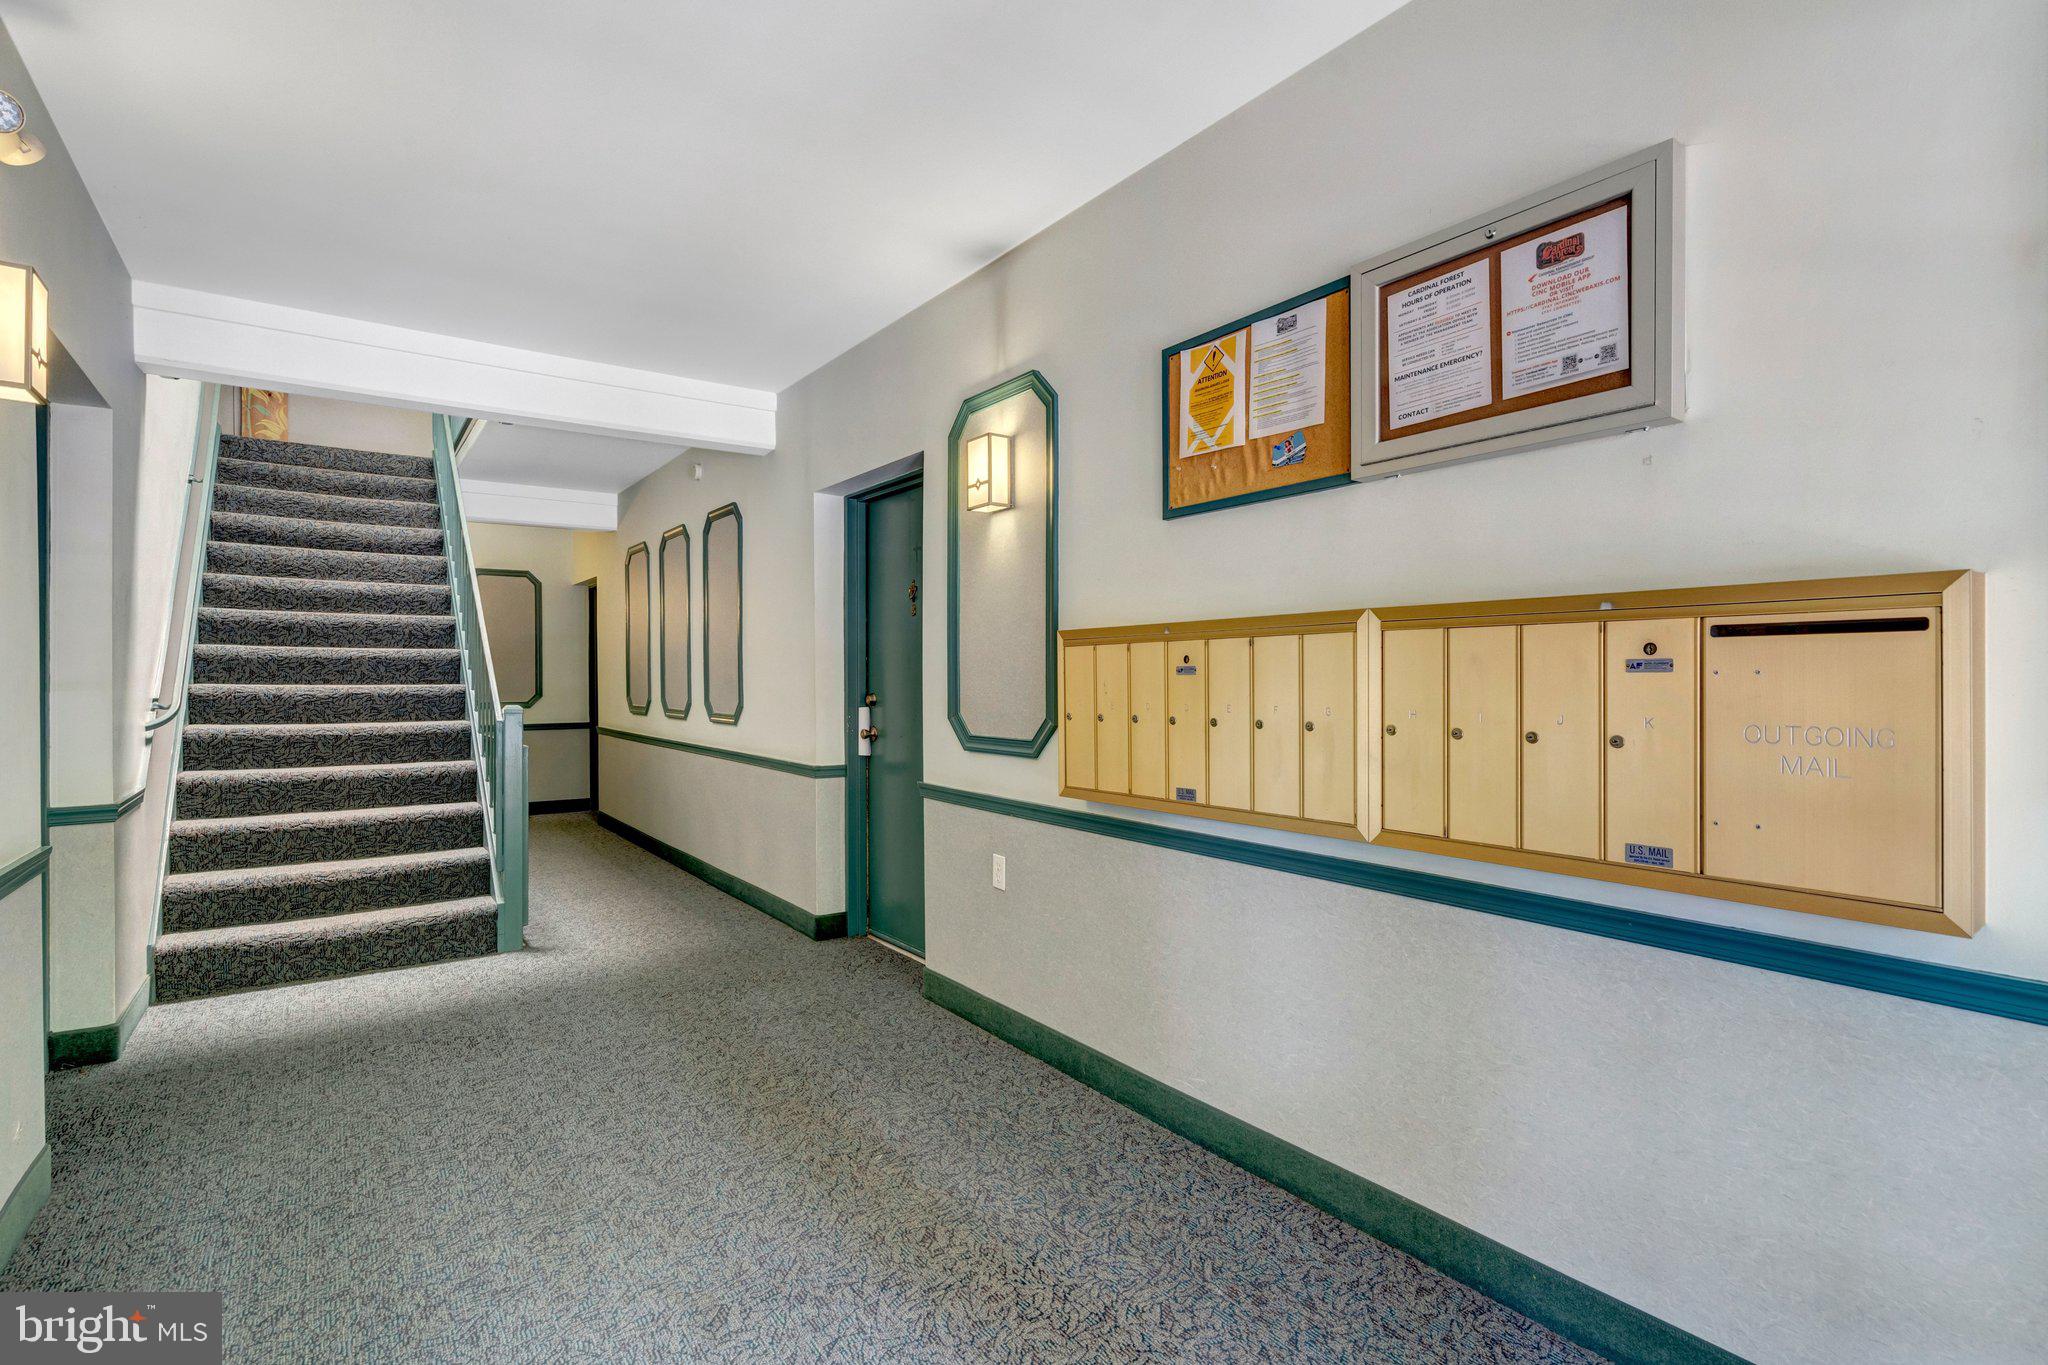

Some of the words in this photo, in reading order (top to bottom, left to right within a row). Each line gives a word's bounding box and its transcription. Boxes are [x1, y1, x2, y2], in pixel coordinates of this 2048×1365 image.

[1408, 281, 1439, 297] CARDINAL
[1440, 271, 1464, 285] FOREST
[1532, 273, 1572, 291] DOWNLOAD
[1574, 268, 1589, 277] OUR
[1532, 288, 1548, 297] CINC
[1550, 279, 1575, 291] MOBILE
[1578, 273, 1591, 282] APP
[1402, 296, 1423, 309] HOURS
[1434, 278, 1472, 297] OPERATION
[1197, 369, 1228, 385] ATTENTION
[1394, 365, 1438, 382] MAINTENANCE
[1439, 351, 1483, 369] EMERGENCY?
[1398, 407, 1429, 420] CONTACT
[1408, 710, 1417, 719] H
[1556, 715, 1564, 726] J
[1643, 716, 1655, 729] K
[1743, 723, 1896, 749] OUTGOING
[1780, 754, 1852, 779] MAIL
[1629, 845, 1646, 856] U.S.
[1648, 847, 1669, 859] MAIL
